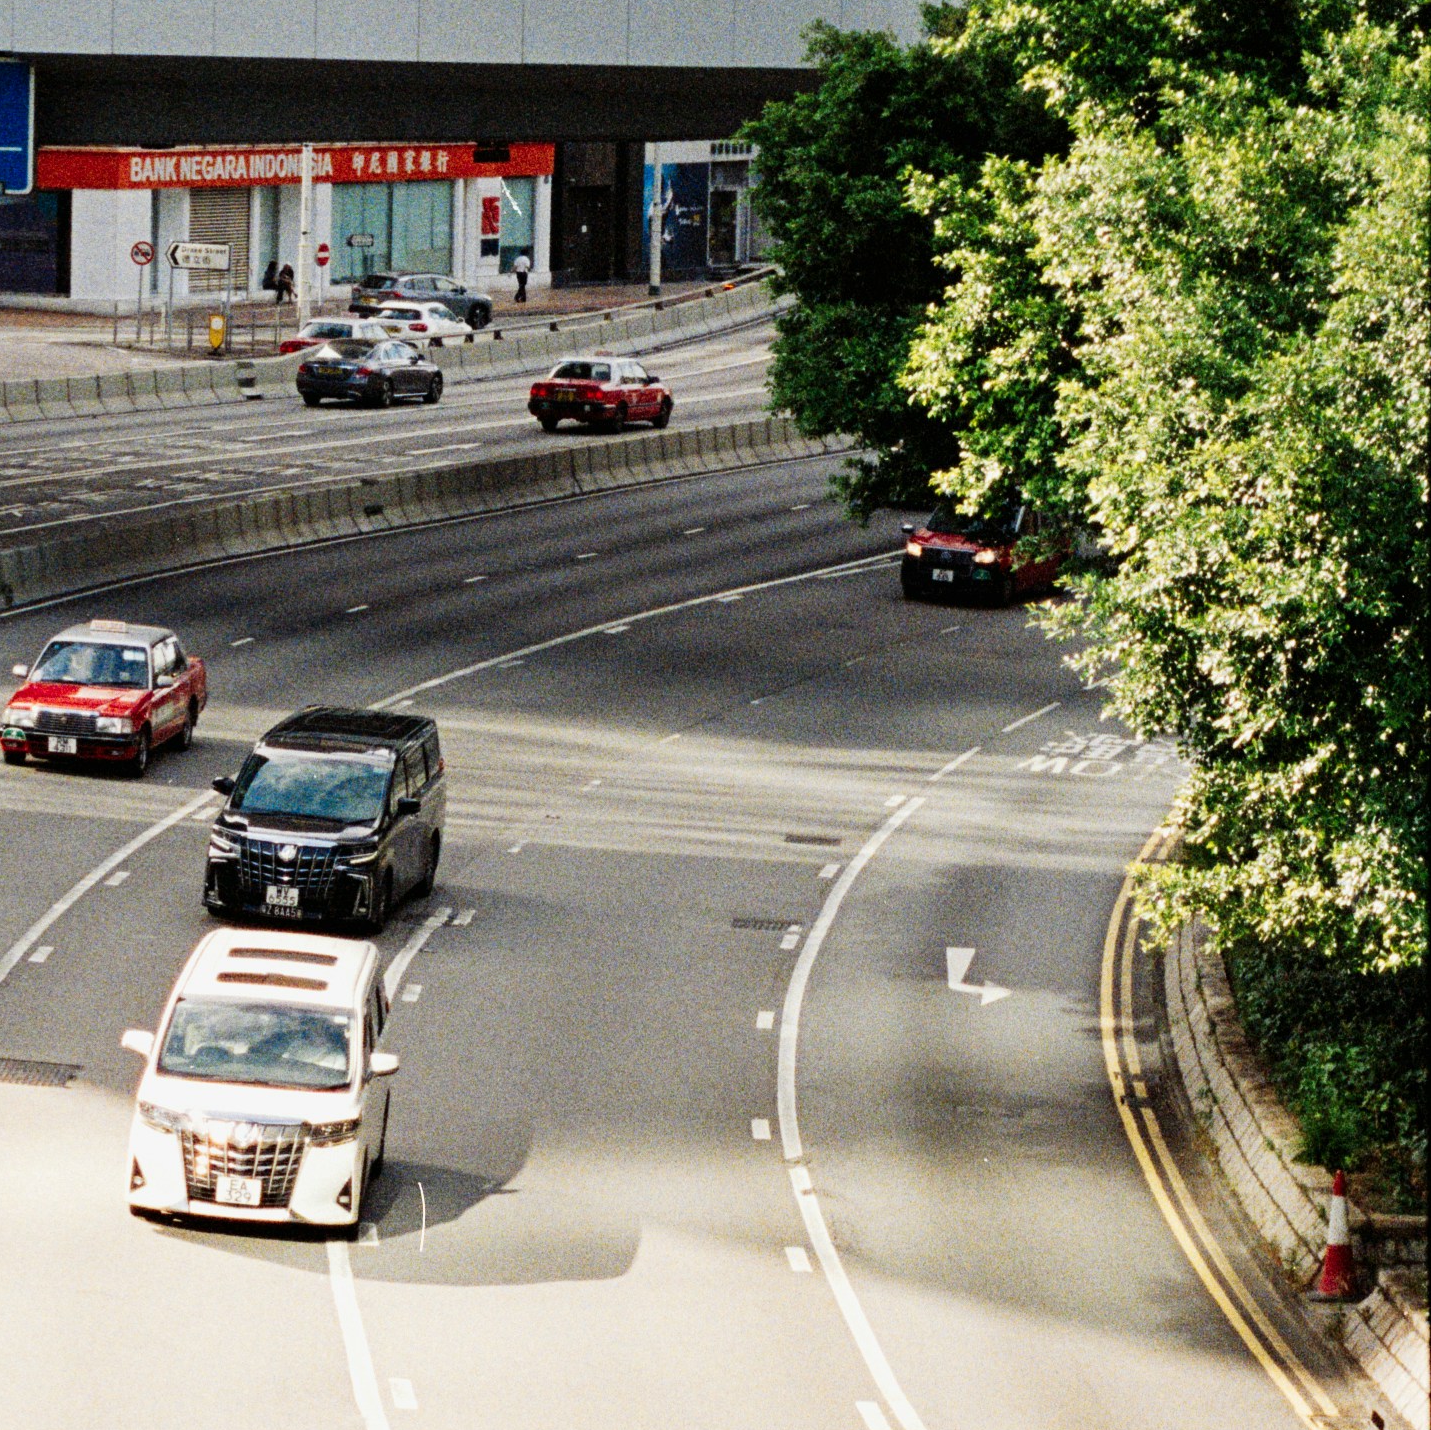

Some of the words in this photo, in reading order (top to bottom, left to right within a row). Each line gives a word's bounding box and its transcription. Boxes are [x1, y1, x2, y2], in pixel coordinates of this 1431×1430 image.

[130, 156, 177, 182] BANK
[180, 154, 247, 180] NEGARA
[230, 1179, 247, 1190] EA
[225, 1189, 252, 1203] 329
